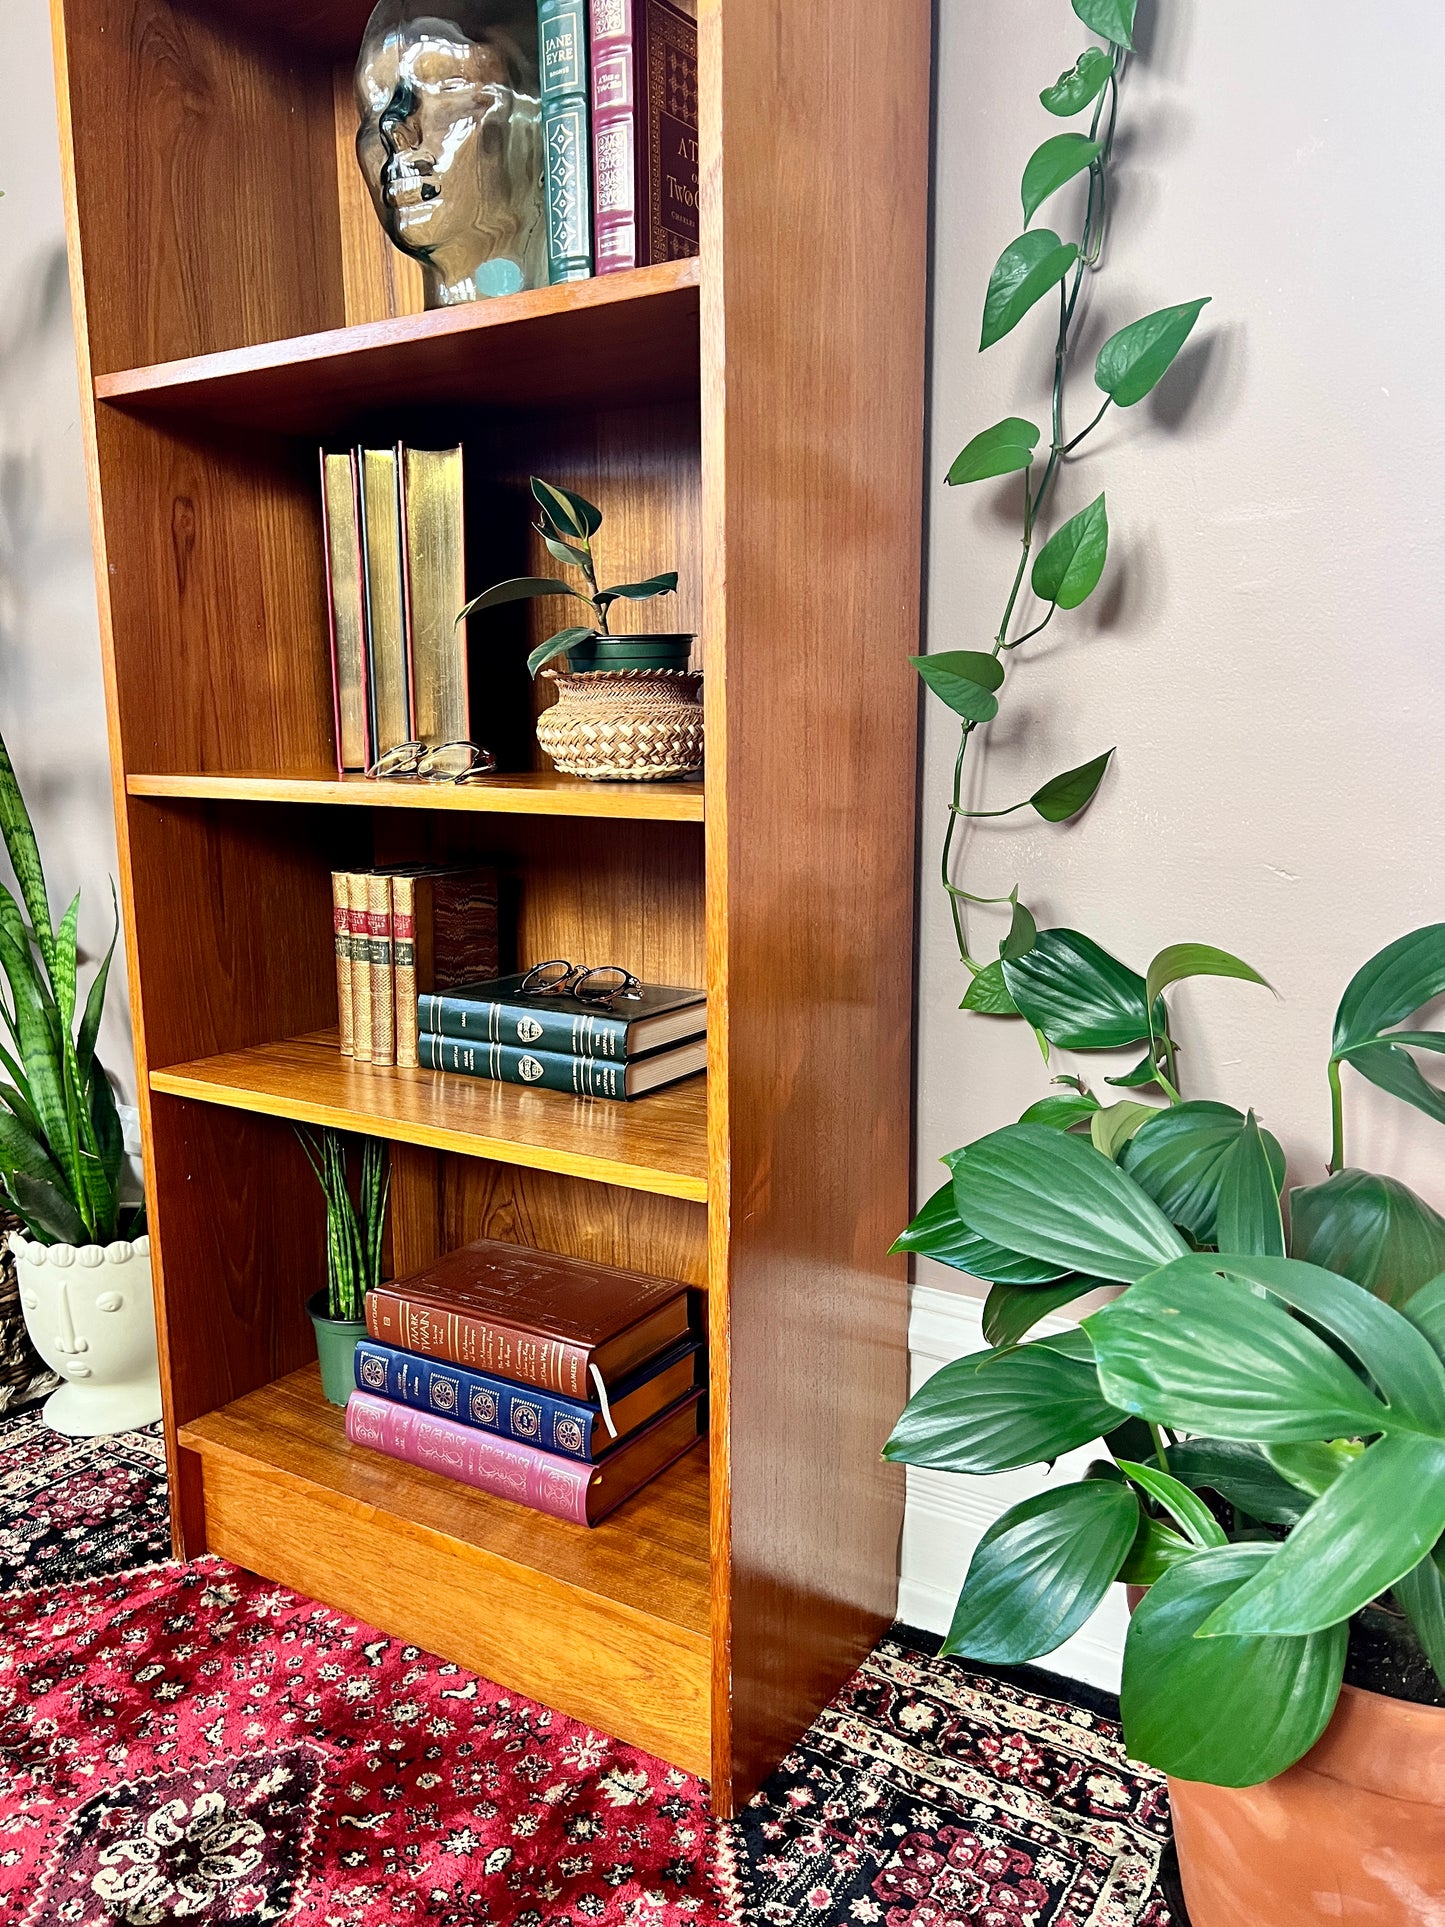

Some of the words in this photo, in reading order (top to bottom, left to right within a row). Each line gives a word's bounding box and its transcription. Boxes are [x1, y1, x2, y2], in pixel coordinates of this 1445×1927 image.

[545, 33, 573, 54] JANE
[546, 48, 573, 66] EYRE
[677, 137, 688, 159] A
[666, 174, 693, 207] TWO
[410, 1313, 420, 1345] MARK
[420, 1310, 431, 1350] TWAIN
[570, 1355, 578, 1393] GRAMERCY
